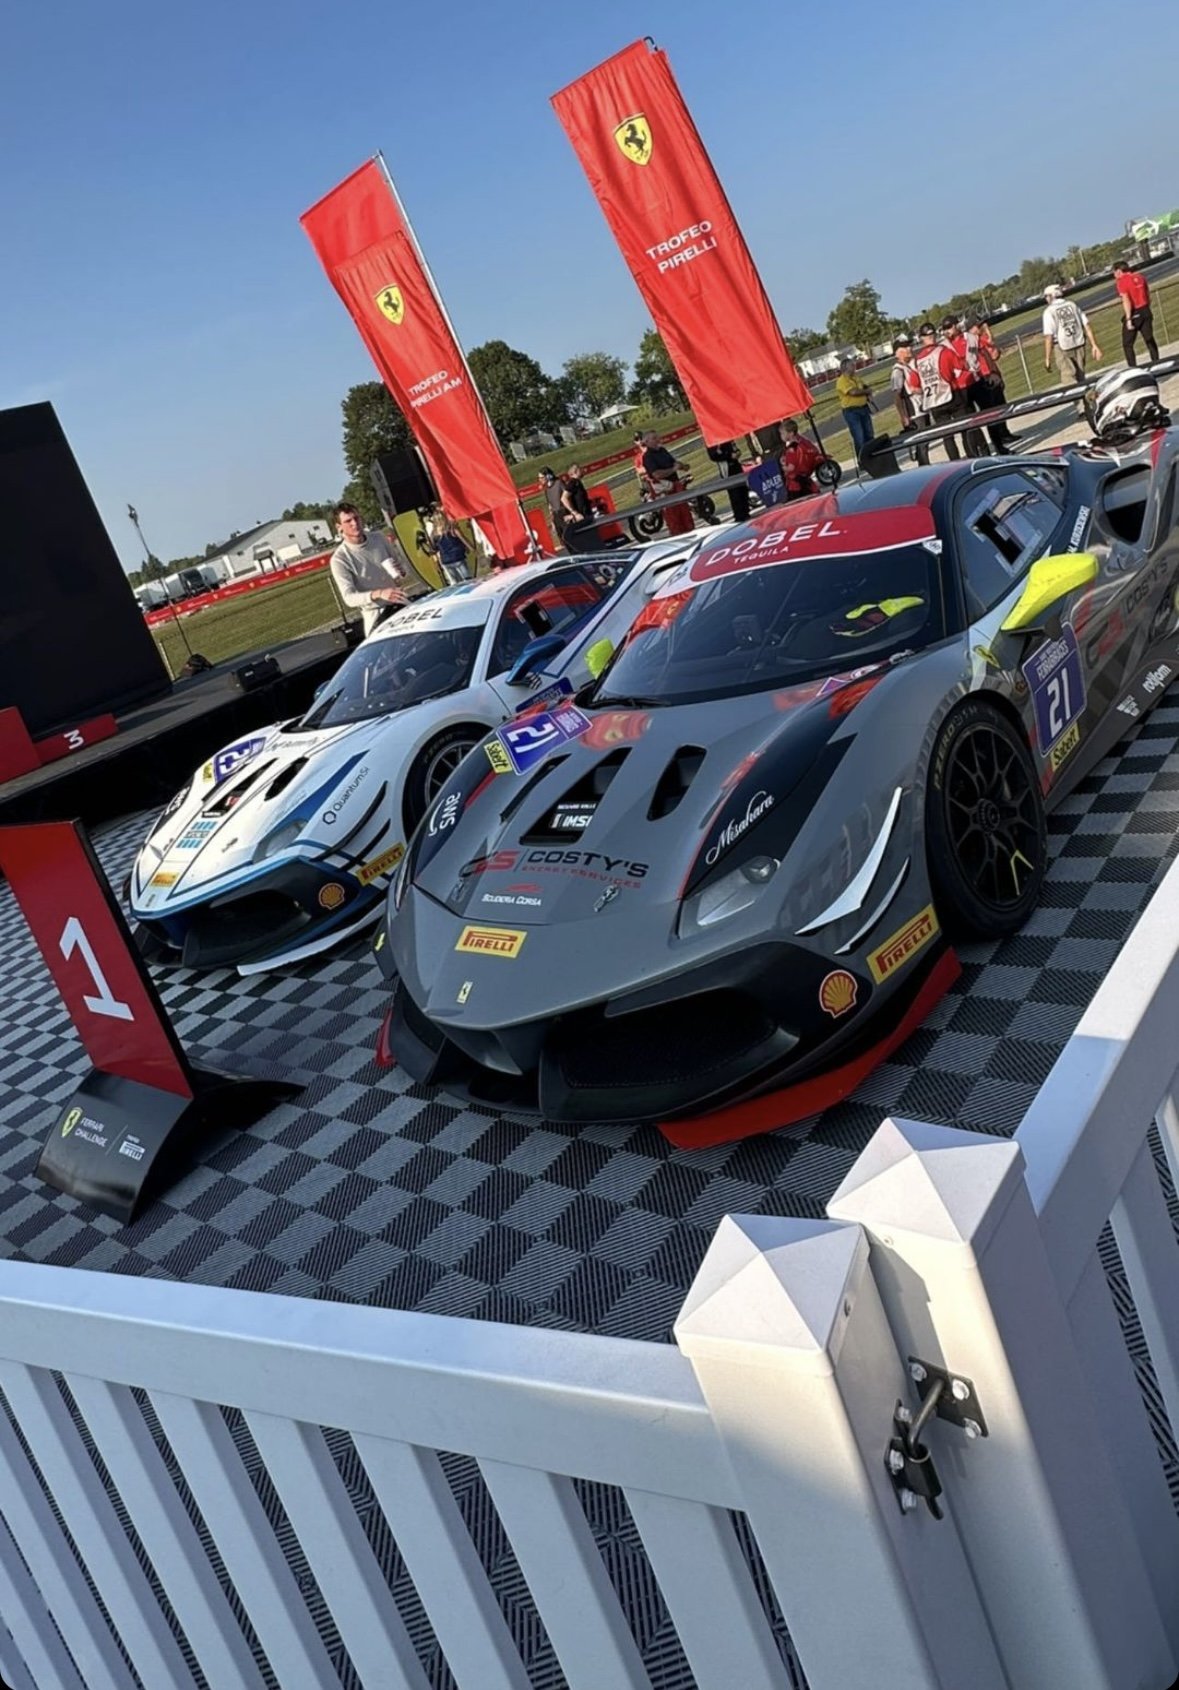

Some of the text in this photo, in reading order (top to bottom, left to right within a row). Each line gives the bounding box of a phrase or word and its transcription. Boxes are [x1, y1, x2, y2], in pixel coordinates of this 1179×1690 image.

[645, 220, 712, 260] TROFEO
[657, 236, 718, 274] PIRELLI
[408, 370, 448, 396] TROFEO
[442, 377, 462, 393] AM
[924, 383, 938, 397] 27
[705, 521, 841, 566] DOBEL
[733, 545, 789, 564] TEQUILA
[1047, 667, 1071, 738] 21
[63, 729, 84, 750] 3
[506, 722, 559, 753] 21
[485, 742, 508, 769] Sabelt
[439, 792, 461, 829] aws
[705, 790, 774, 865] Misahara
[528, 851, 649, 878] COSTY'S
[462, 930, 518, 952] PIRELLI
[875, 914, 932, 975] PIRELLI
[59, 916, 135, 1021] 1
[75, 1128, 108, 1147] CHALLENGE
